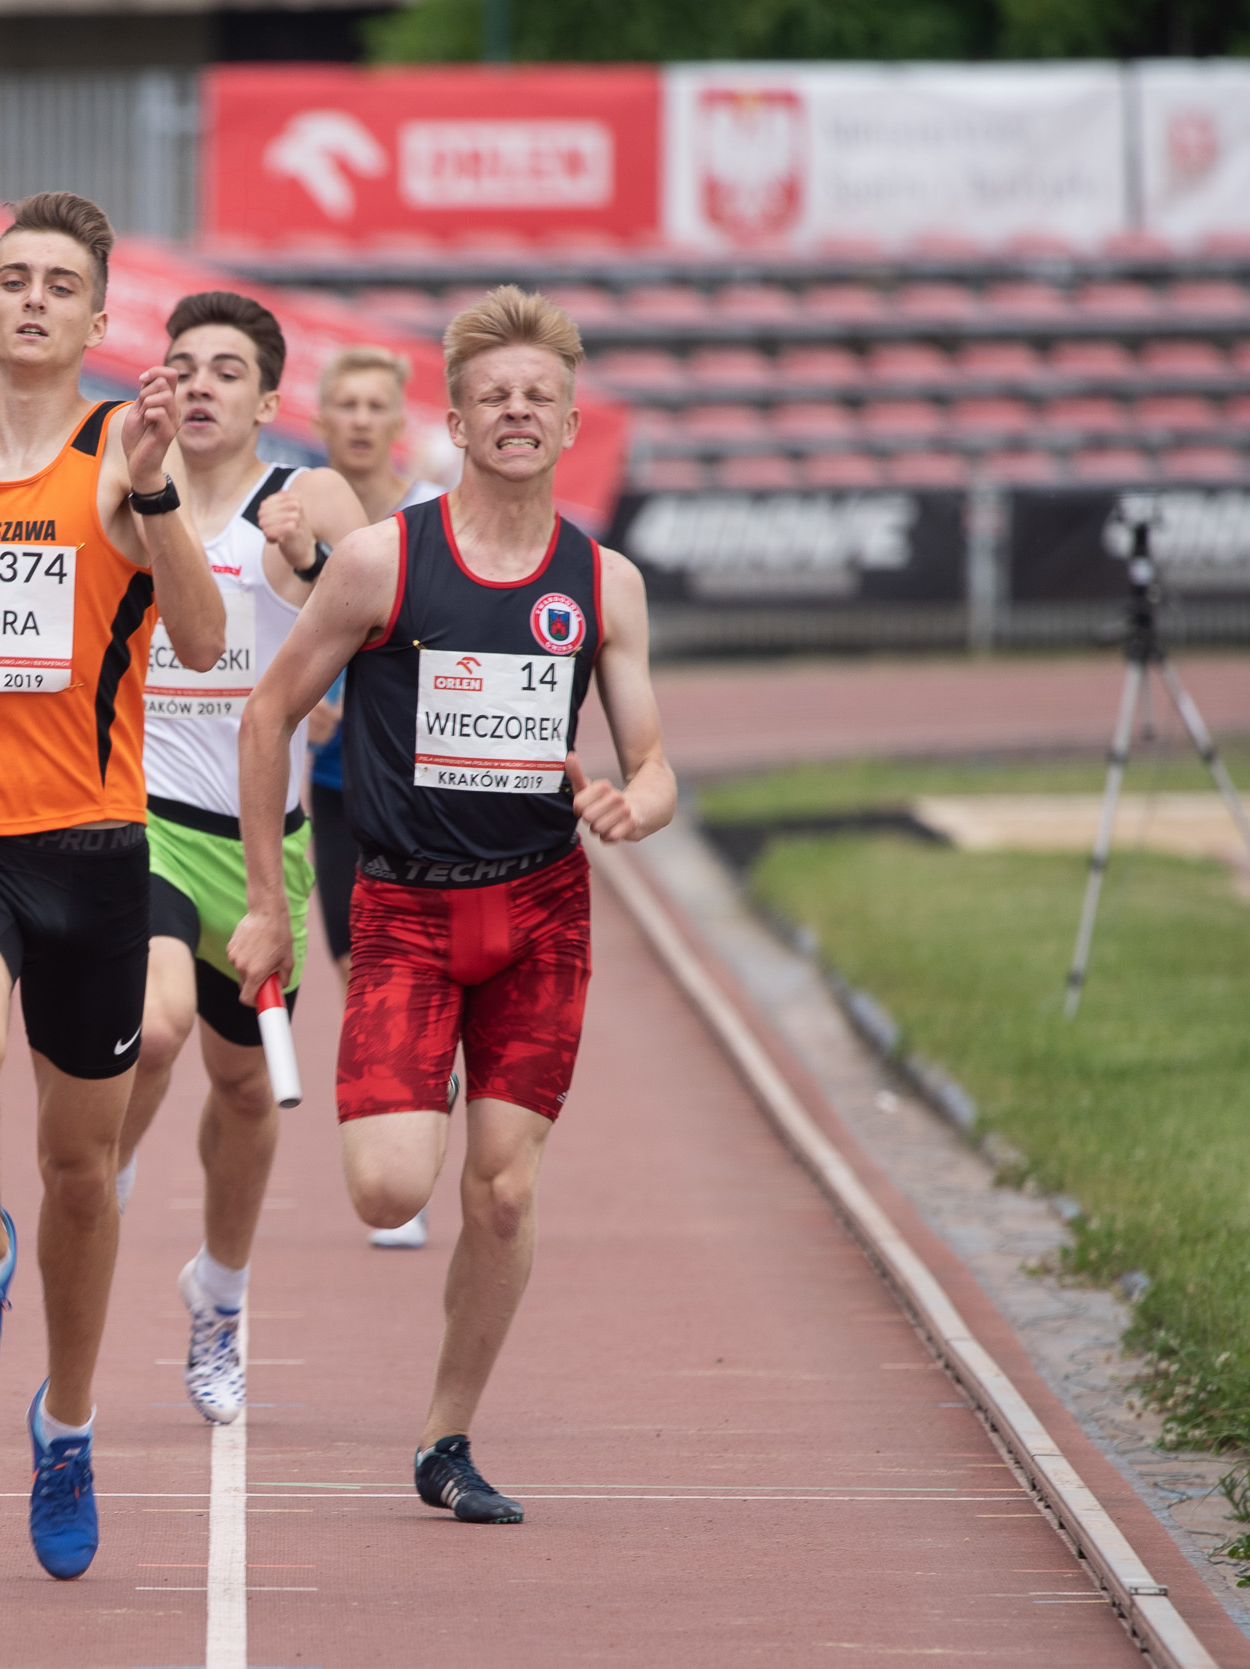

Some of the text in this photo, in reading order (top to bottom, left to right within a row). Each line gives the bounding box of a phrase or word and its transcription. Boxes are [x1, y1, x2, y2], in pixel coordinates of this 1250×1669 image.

[4, 673, 43, 688] 2019
[436, 678, 481, 690] ORLEN
[521, 662, 557, 692] 14
[197, 702, 232, 715] 2019
[425, 711, 563, 741] WIECZOREK
[438, 770, 543, 789] KRAKÓW 2019
